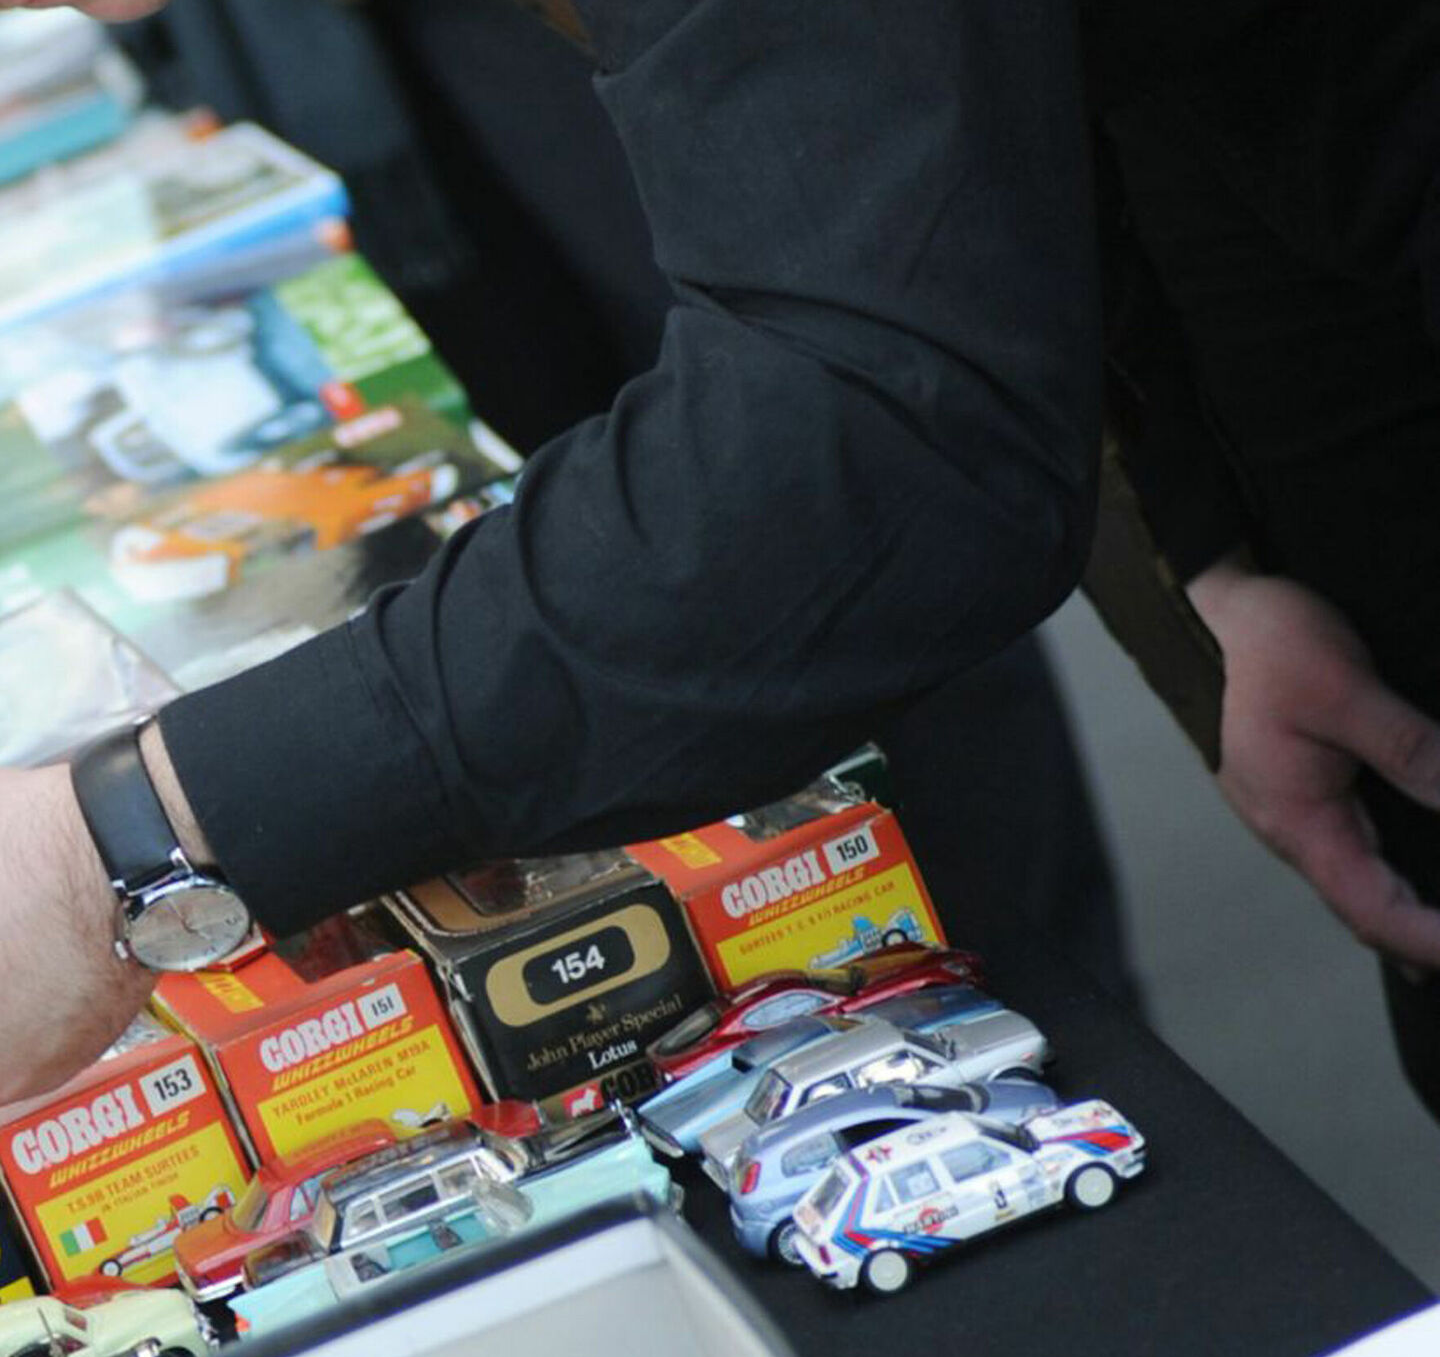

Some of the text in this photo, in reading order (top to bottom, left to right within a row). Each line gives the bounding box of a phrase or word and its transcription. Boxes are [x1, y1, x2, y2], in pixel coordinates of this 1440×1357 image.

[721, 850, 826, 919] CORGI
[835, 835, 869, 863] 150
[550, 944, 606, 984] 154
[260, 995, 395, 1074] CORGI 151
[272, 1015, 415, 1092] WHIZZWHEELS
[527, 994, 684, 1072] John Player Special
[587, 1039, 639, 1071] Lotus
[11, 1068, 192, 1176] CORGI 153
[273, 1084, 330, 1119] YARDLEY
[354, 1076, 396, 1106] Racing
[395, 1064, 417, 1081] Car
[48, 1110, 190, 1189] WHIZZWHEELS
[103, 1171, 143, 1199] TEAM
[145, 1144, 200, 1179] SURTEES
